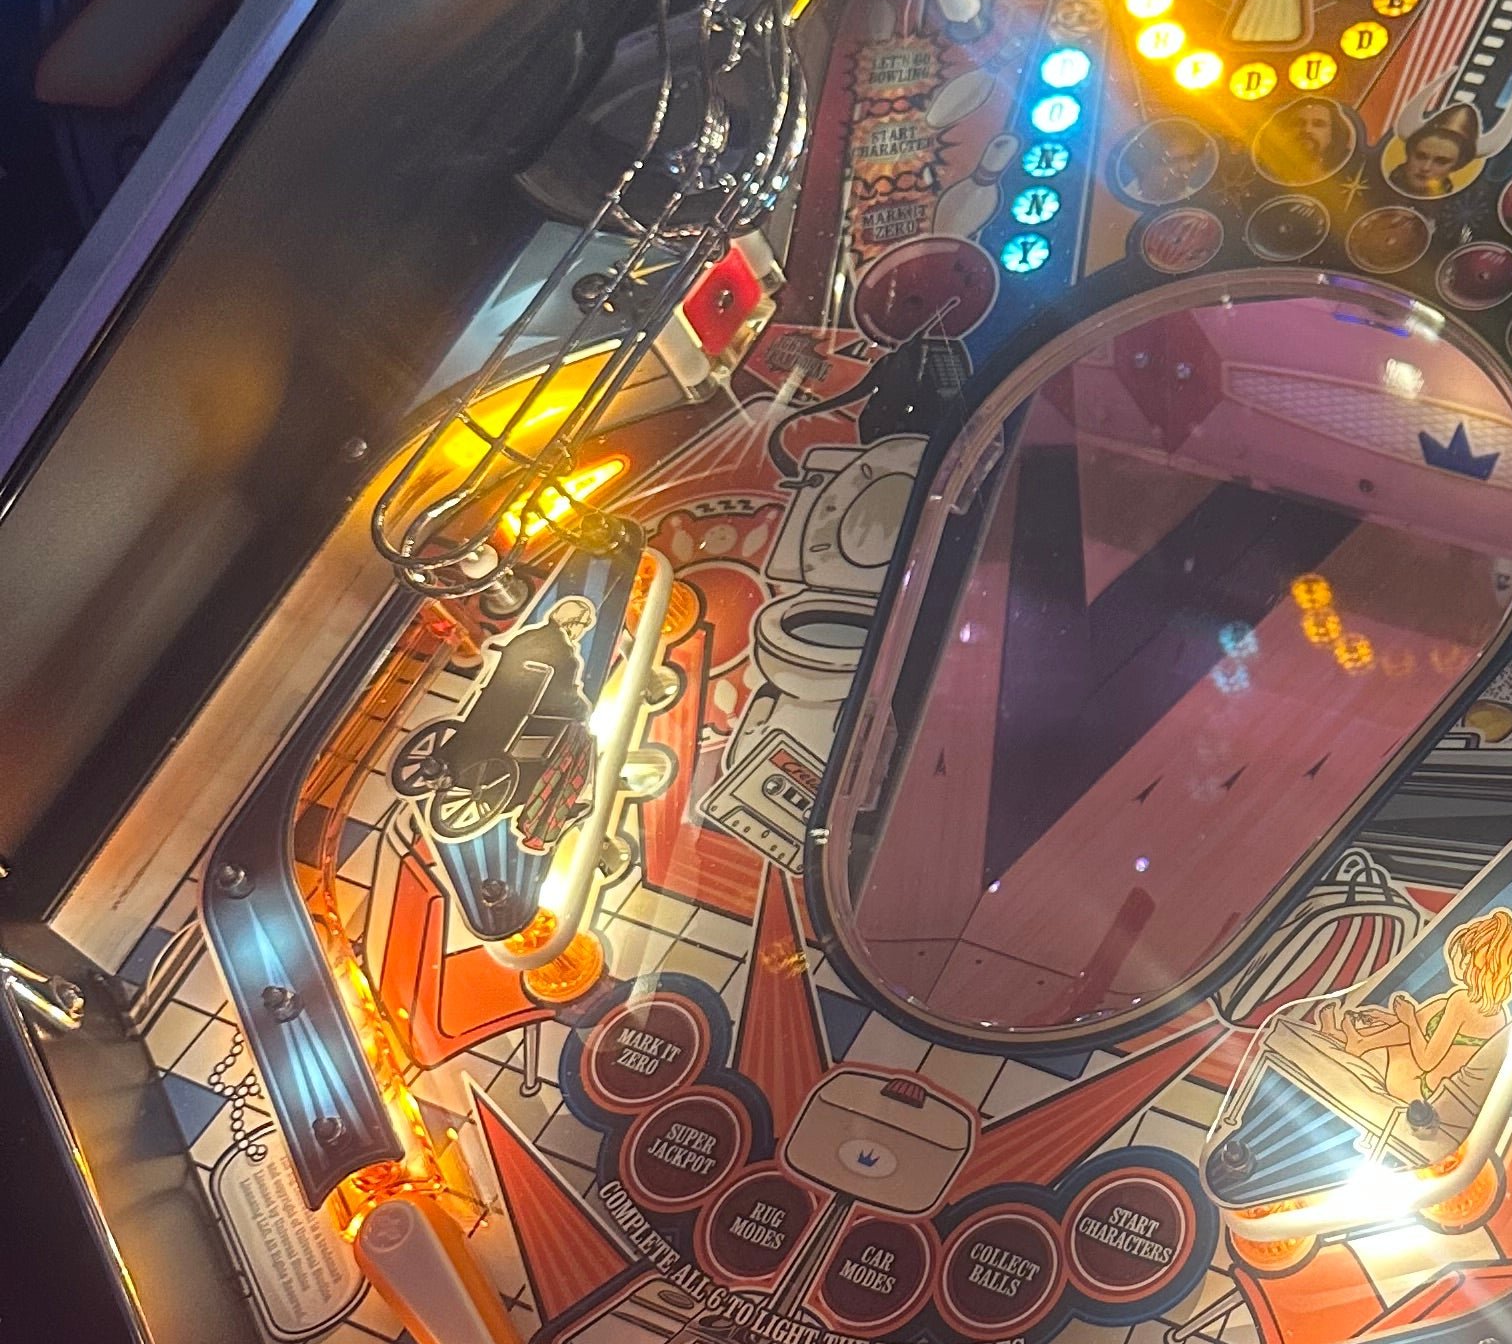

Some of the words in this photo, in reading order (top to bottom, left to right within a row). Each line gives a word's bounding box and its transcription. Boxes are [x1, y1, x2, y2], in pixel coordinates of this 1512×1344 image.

[870, 125, 917, 145] START
[874, 220, 916, 240] ZERO
[617, 1028, 660, 1053] MARK
[660, 1042, 681, 1062] IT
[617, 1046, 659, 1076] ZERO
[666, 1122, 718, 1154] SUPER
[647, 1137, 716, 1175] JACKPOT
[750, 1202, 785, 1227] RUG
[1108, 1206, 1160, 1239] START
[729, 1216, 785, 1251] MODES
[1078, 1216, 1172, 1264] CHARACTERS
[600, 1179, 673, 1274] COMPLETE
[670, 1258, 707, 1300] ALL
[706, 1286, 724, 1309] 6
[724, 1293, 755, 1327] TO
[860, 1245, 896, 1273] CAR
[969, 1241, 1040, 1283] COLLECT
[839, 1261, 897, 1295] MODES
[967, 1264, 1022, 1298] BALLS
